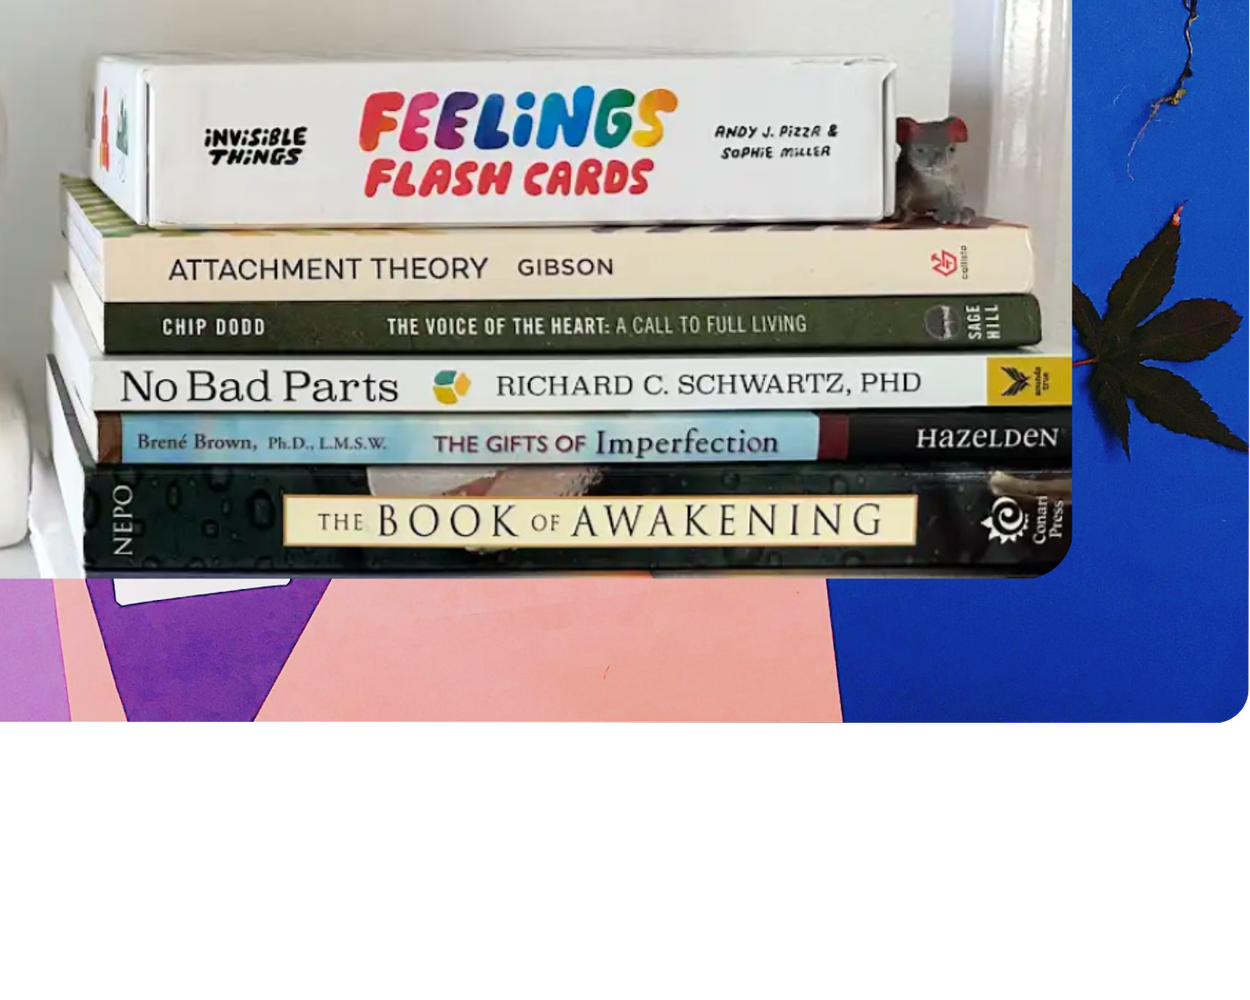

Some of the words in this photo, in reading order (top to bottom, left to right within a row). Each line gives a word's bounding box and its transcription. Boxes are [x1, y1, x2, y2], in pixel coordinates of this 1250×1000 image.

[714, 124, 758, 139] ANDY
[762, 125, 775, 139] J.
[827, 123, 839, 138] &
[364, 158, 513, 198] FLASH
[523, 157, 655, 197] CARDS
[168, 257, 363, 281] ATTACHMENT
[370, 257, 489, 280] THEORY
[517, 258, 613, 277] GIBSON
[162, 318, 207, 336] CHIP
[216, 318, 265, 336] DODD
[387, 318, 419, 336] THE
[425, 317, 478, 336] VOICE
[484, 317, 506, 336] OF
[512, 317, 545, 335] THE
[551, 316, 610, 335] HEART:
[616, 317, 627, 334] A
[632, 316, 673, 334] CALL
[680, 315, 700, 334] TO
[707, 315, 746, 334] FULL
[752, 314, 807, 333] LIVING
[967, 305, 982, 340] SAGE
[985, 304, 1001, 340] HILL
[120, 370, 178, 403] No
[187, 369, 272, 403] Bad
[283, 370, 399, 403] Parts
[496, 375, 634, 397] RICHARD
[643, 374, 669, 396] C.
[678, 373, 852, 397] SCHWARTZ,
[861, 372, 922, 394] PHD
[137, 432, 188, 450] Brené
[193, 433, 258, 454] Brown,
[268, 435, 314, 452] Ph.D.,
[318, 436, 388, 451] L.M.S.W.
[434, 435, 478, 453] THE
[486, 435, 547, 453] GIFTS
[555, 435, 586, 453] OF
[595, 429, 779, 461] Imperfection
[112, 484, 133, 556] NEPO
[318, 512, 363, 532] THE
[378, 504, 520, 537] BOOK
[530, 513, 560, 532] OF
[570, 503, 882, 538] AWAKENING
[1033, 496, 1048, 544] Conari
[1049, 499, 1063, 538] Press
